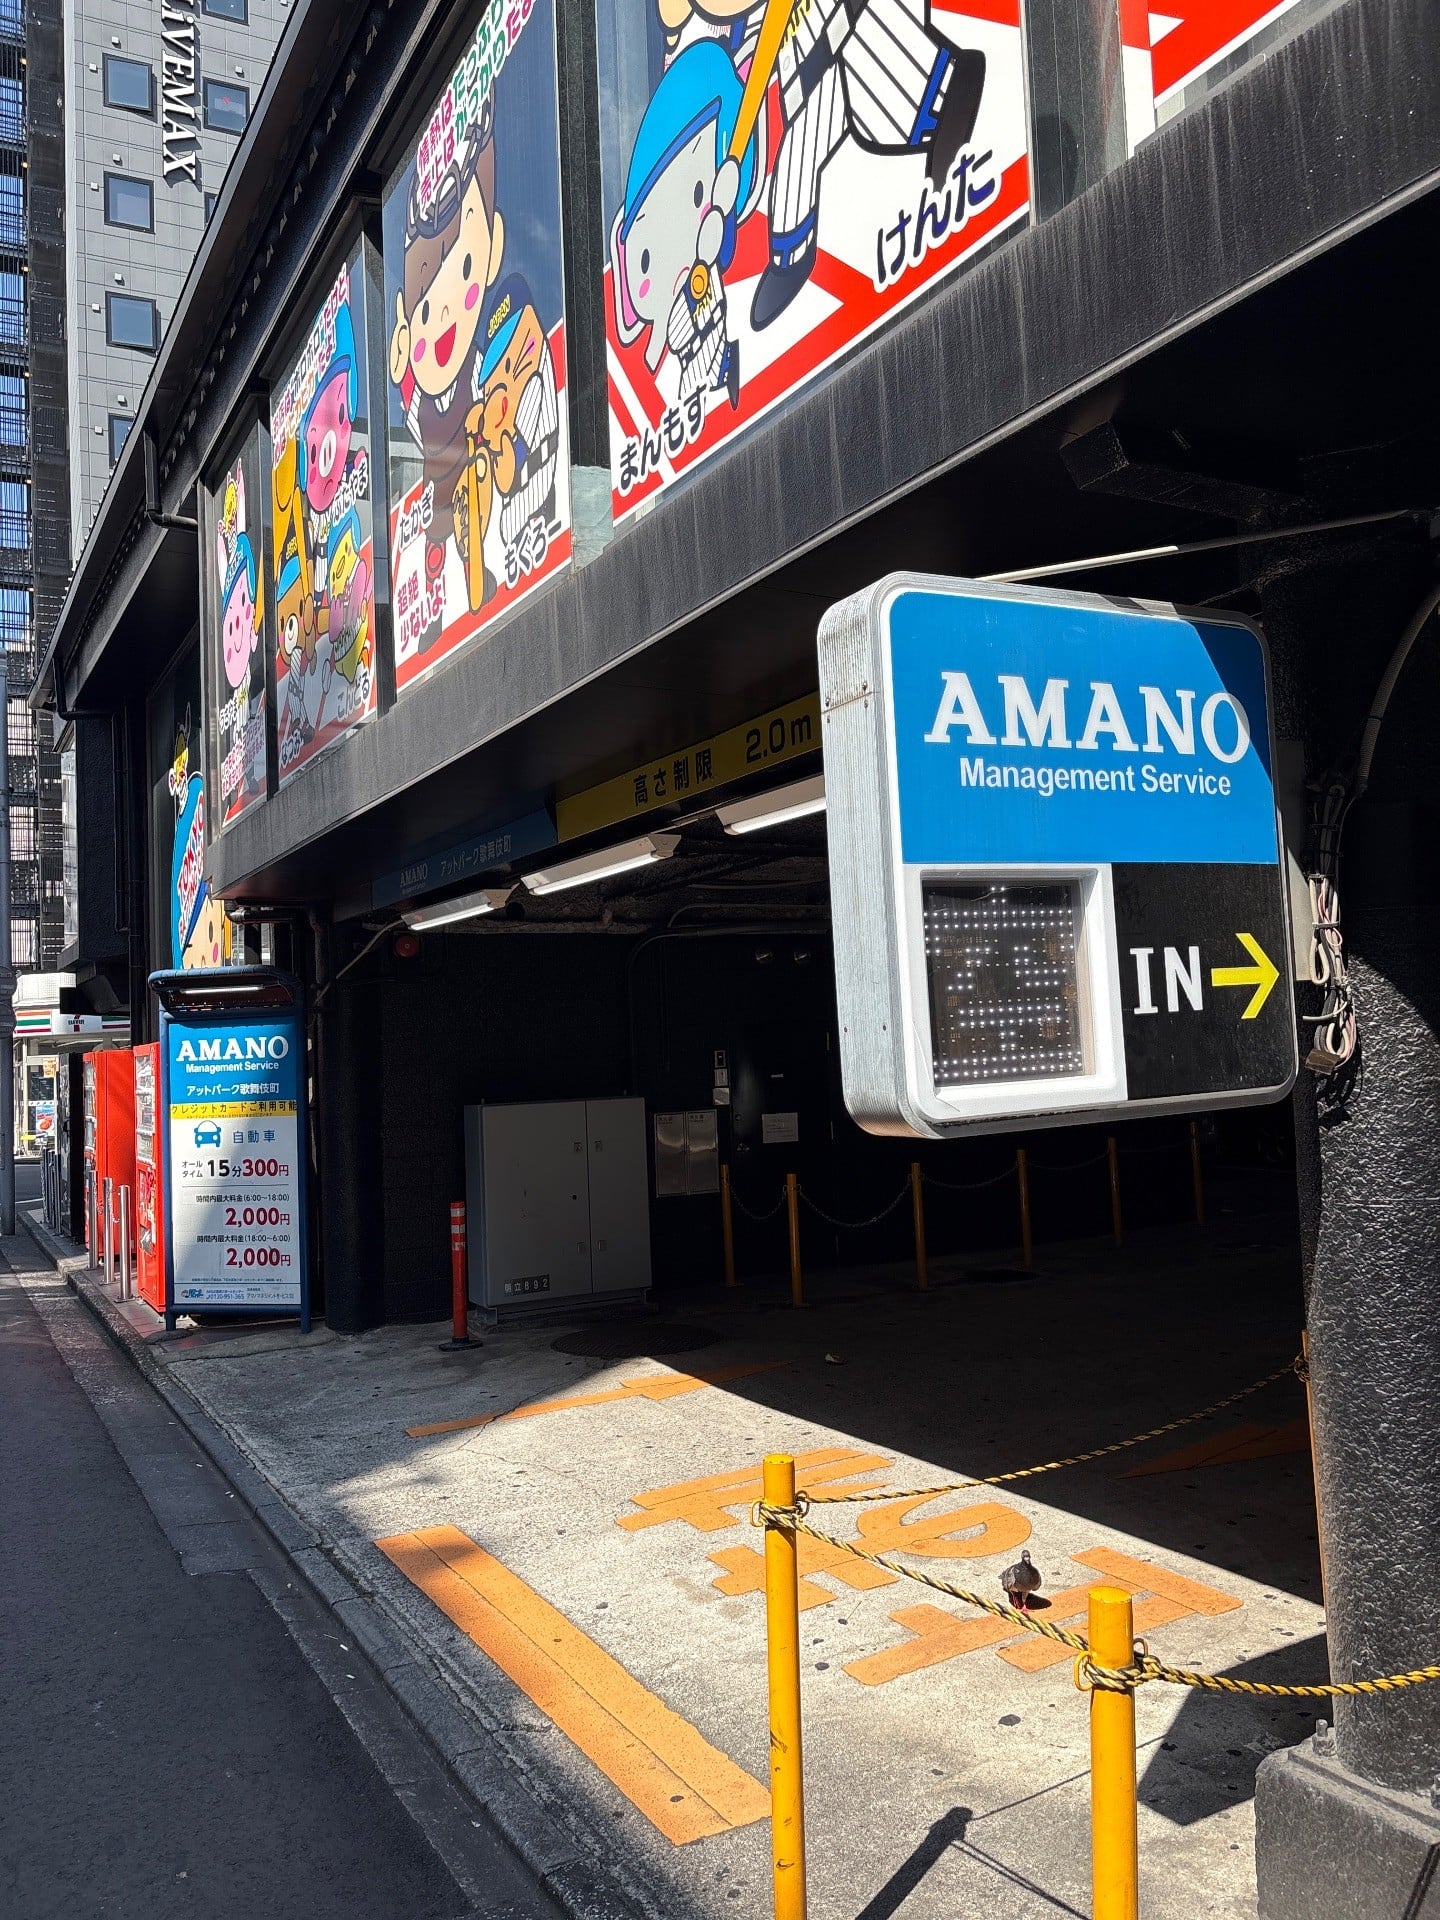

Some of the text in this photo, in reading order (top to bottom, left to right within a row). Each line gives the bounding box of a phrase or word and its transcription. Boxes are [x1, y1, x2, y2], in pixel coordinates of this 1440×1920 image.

[877, 150, 995, 284] けんた
[488, 294, 511, 336] JAPAN
[619, 384, 707, 490] まんもす
[399, 487, 432, 549] たかぎ
[398, 569, 419, 617] 超絶
[400, 574, 447, 652] 少ないよ!
[924, 671, 1251, 764] AMANO
[632, 714, 812, 807] 高さ制限 2.0m
[960, 758, 1232, 797] Management Service
[400, 862, 429, 888] AMANO
[1129, 945, 1204, 1015] IN
[176, 1036, 289, 1061] AMANO
[186, 1060, 279, 1075] Management Service
[187, 1083, 280, 1097] アットパーク歌舞伎町
[171, 1100, 298, 1115] クレジットカードご利用可能
[233, 1130, 276, 1144] 自動車
[182, 1160, 204, 1168] オール
[182, 1170, 204, 1178] タイム
[225, 1207, 290, 1228] 2,000円
[226, 1247, 291, 1268] 2,000円
